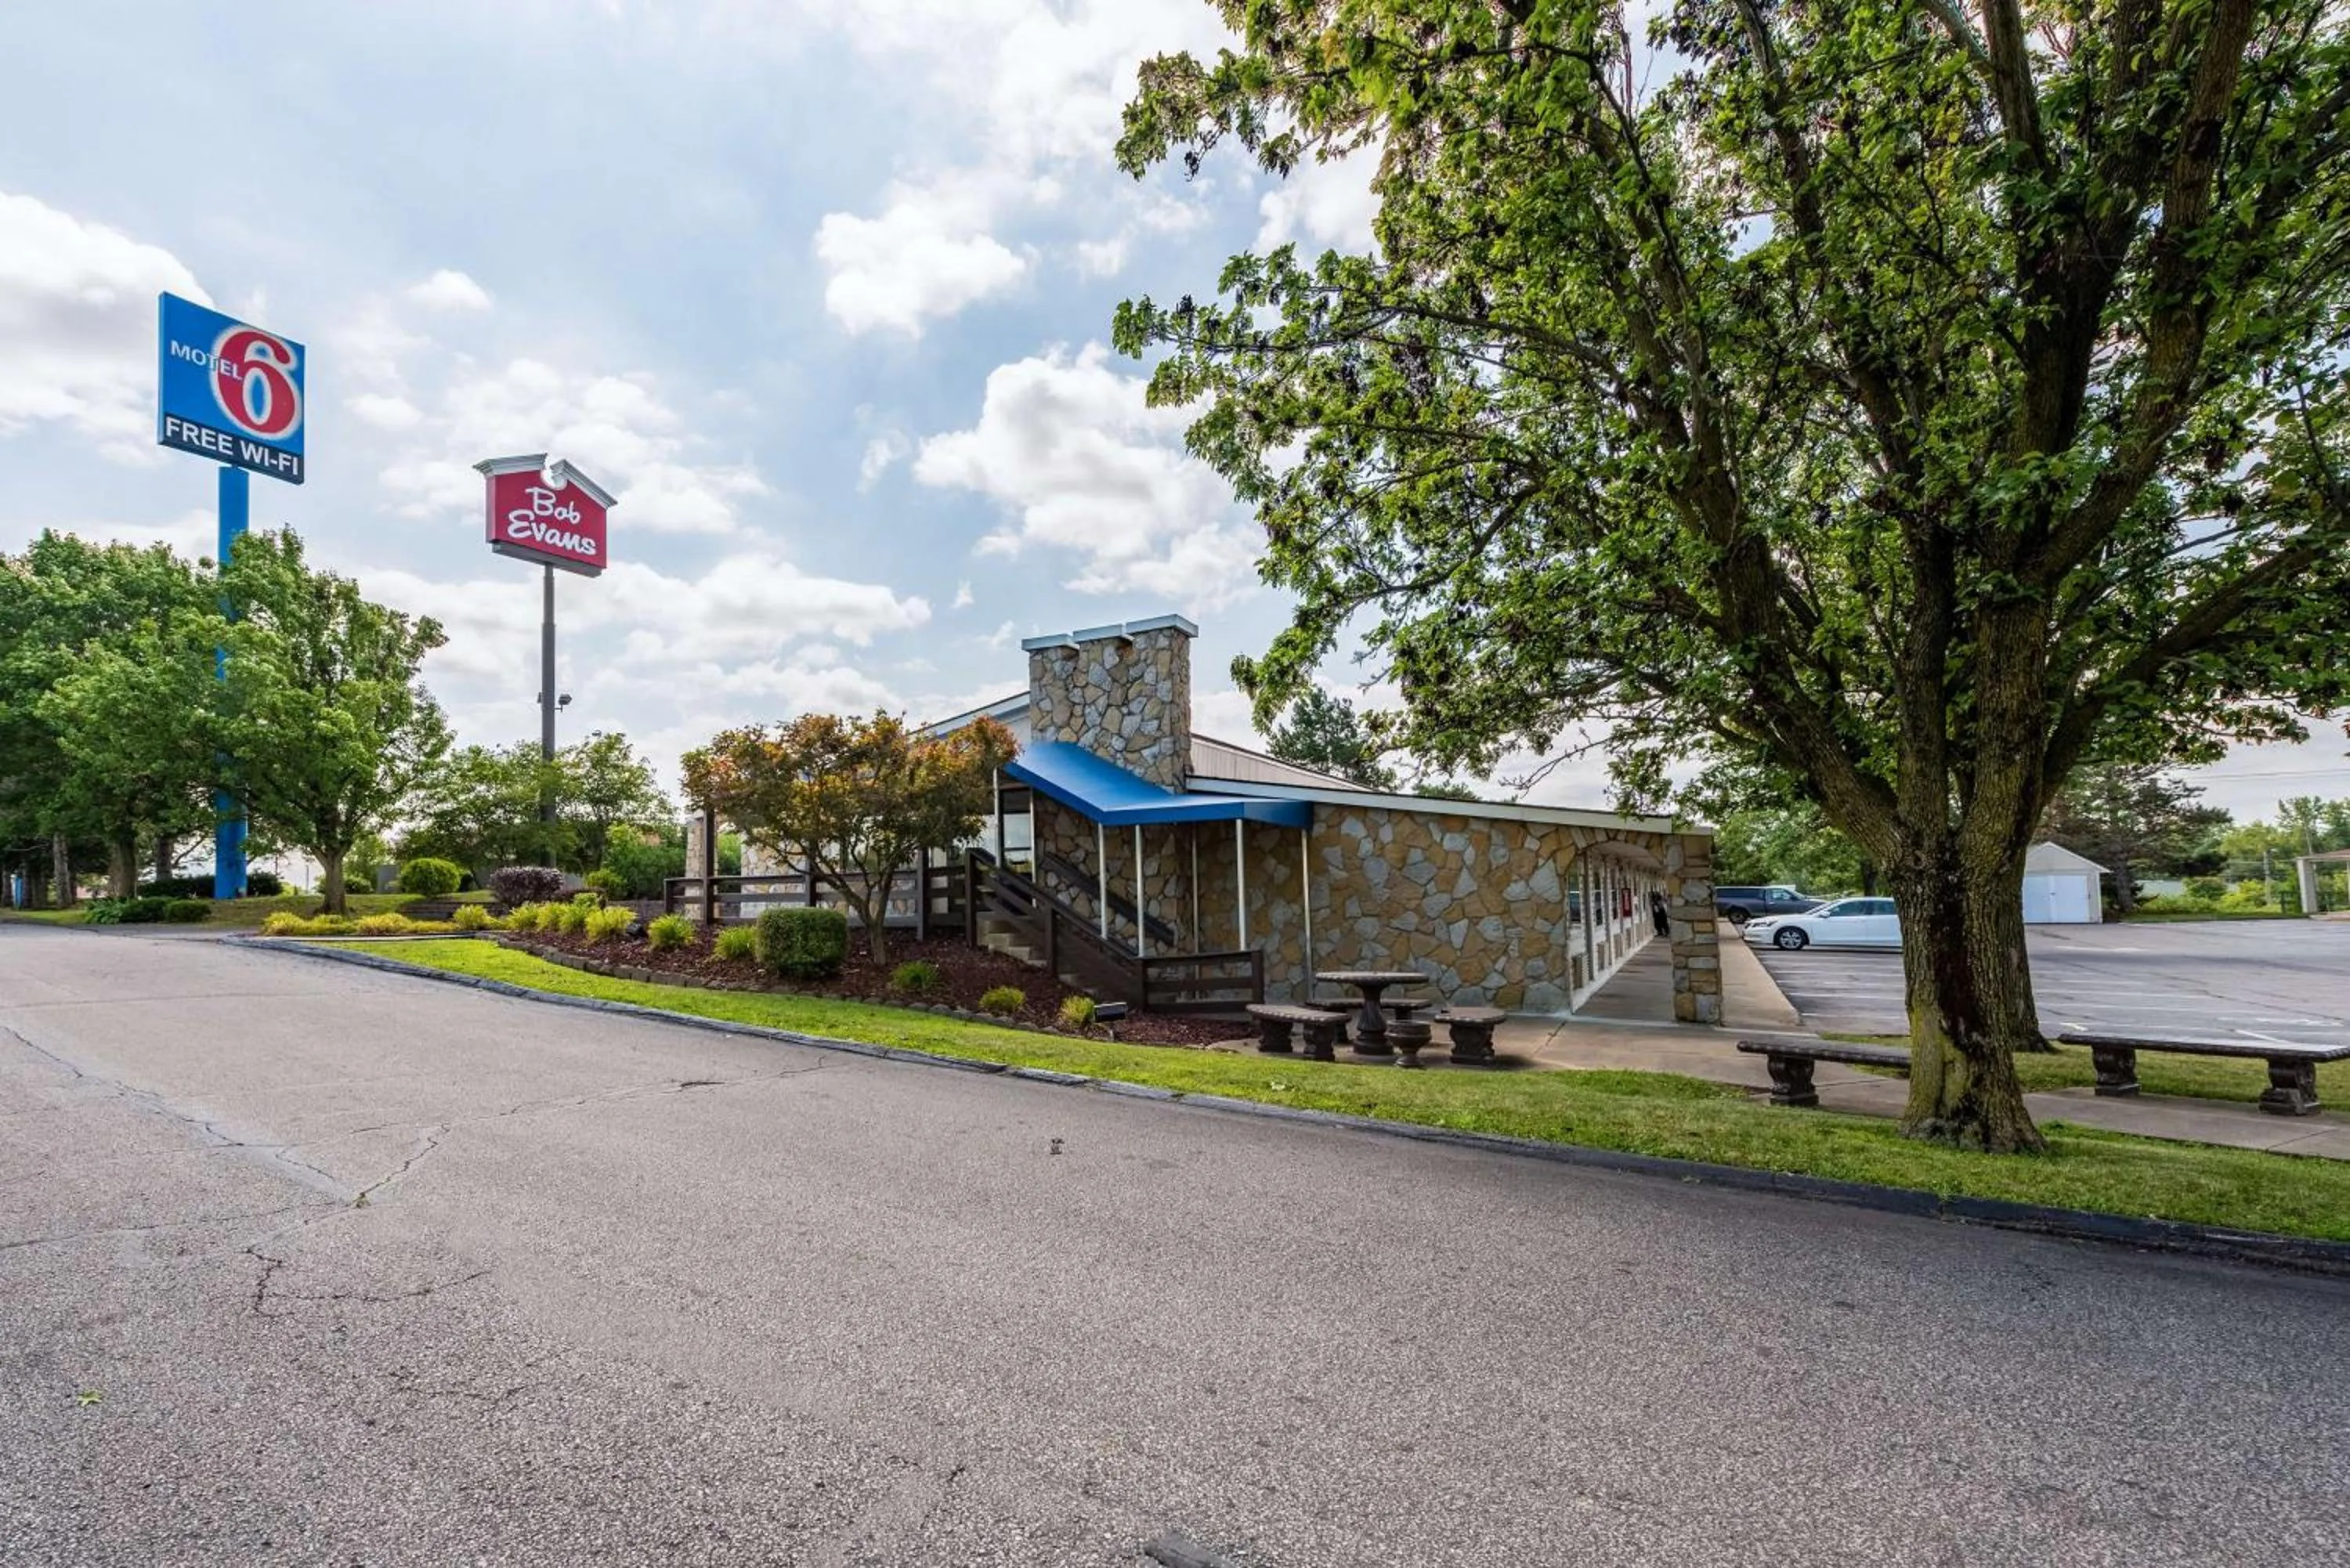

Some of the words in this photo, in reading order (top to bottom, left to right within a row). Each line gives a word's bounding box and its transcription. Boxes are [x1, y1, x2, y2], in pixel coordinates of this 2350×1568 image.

[171, 340, 244, 381] MOTEL
[212, 327, 302, 439] 6
[165, 416, 234, 456] FREE
[240, 440, 298, 475] WI-FI
[526, 486, 580, 524] Bob
[508, 509, 597, 555] Evans
